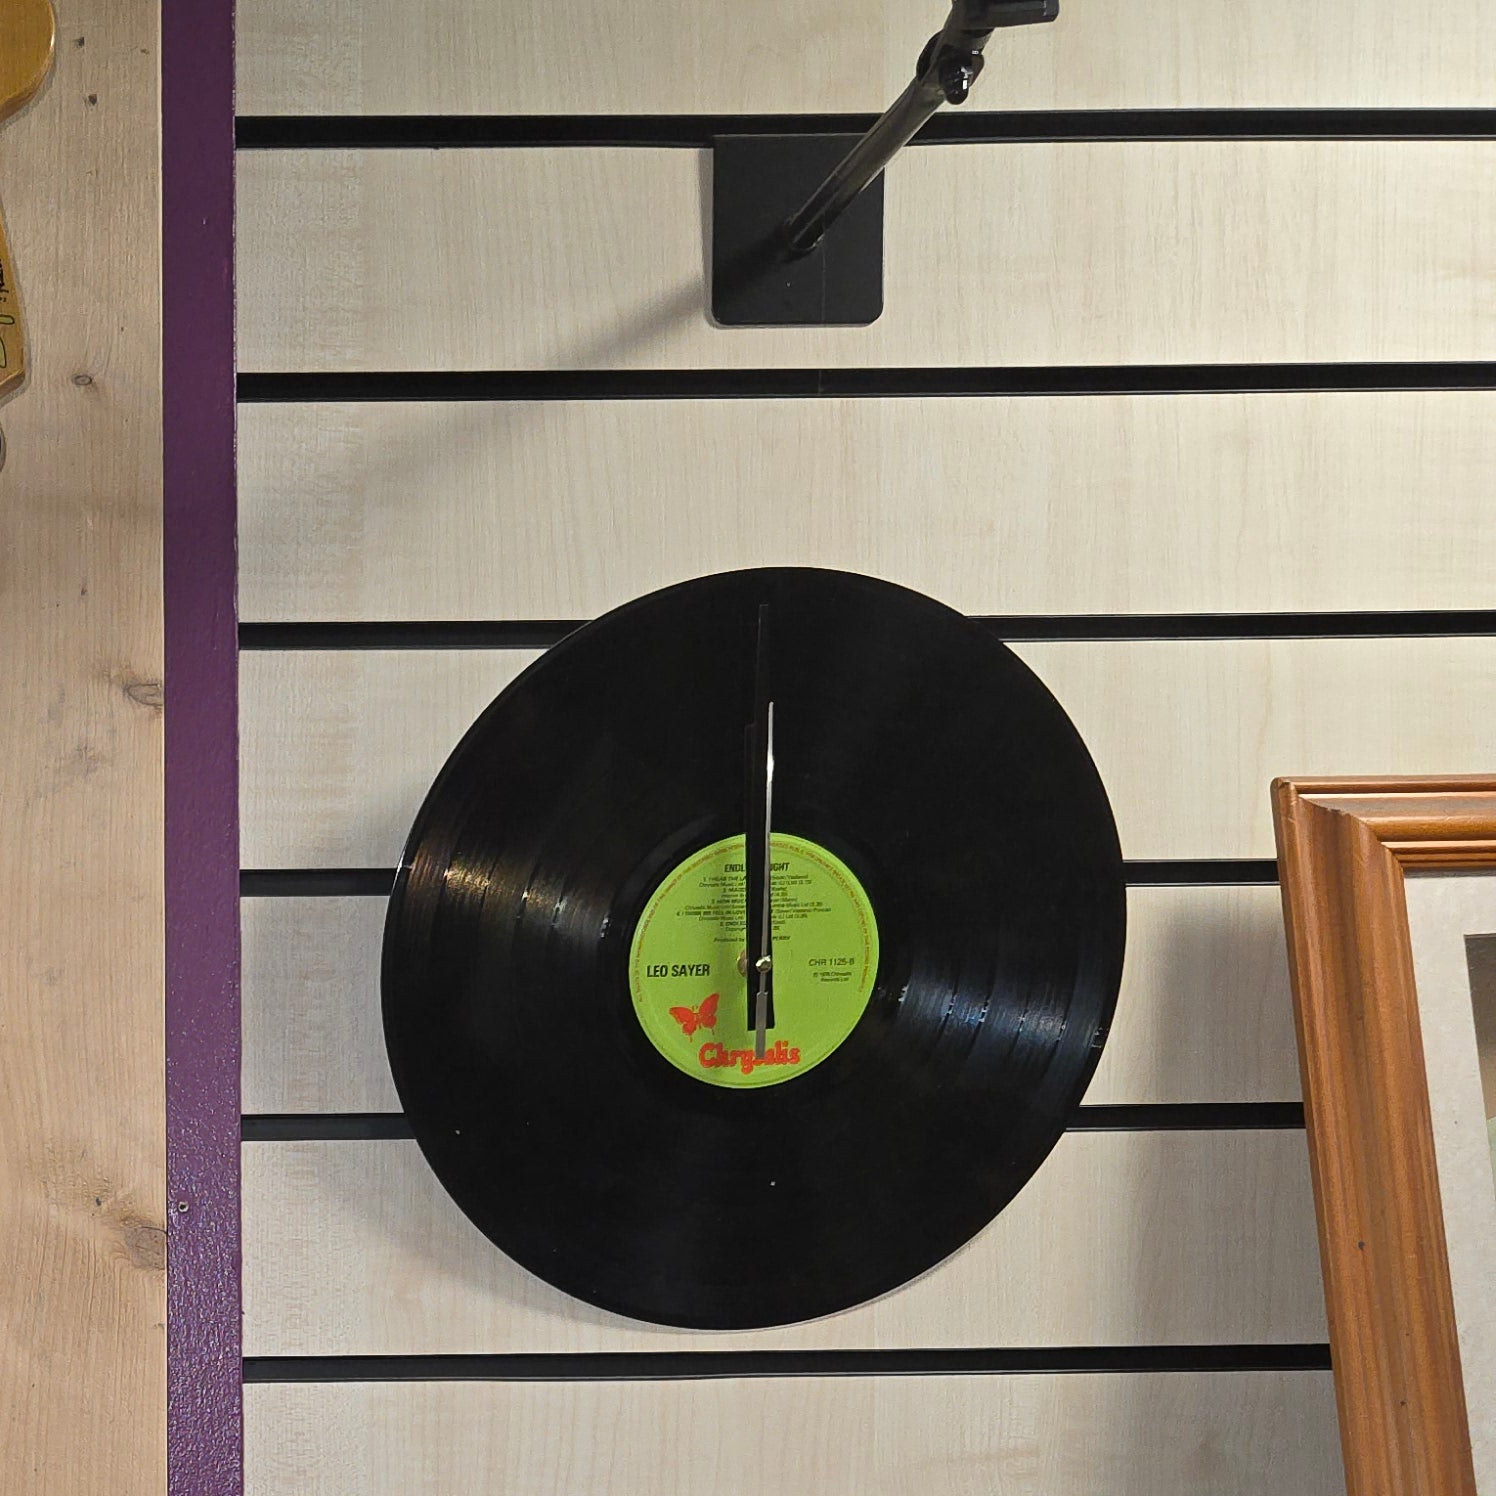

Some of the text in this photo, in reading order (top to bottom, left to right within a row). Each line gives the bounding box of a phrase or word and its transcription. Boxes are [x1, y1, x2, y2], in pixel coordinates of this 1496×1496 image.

[647, 964, 710, 977] LEO SAYER
[698, 1040, 801, 1075] Chryalis
